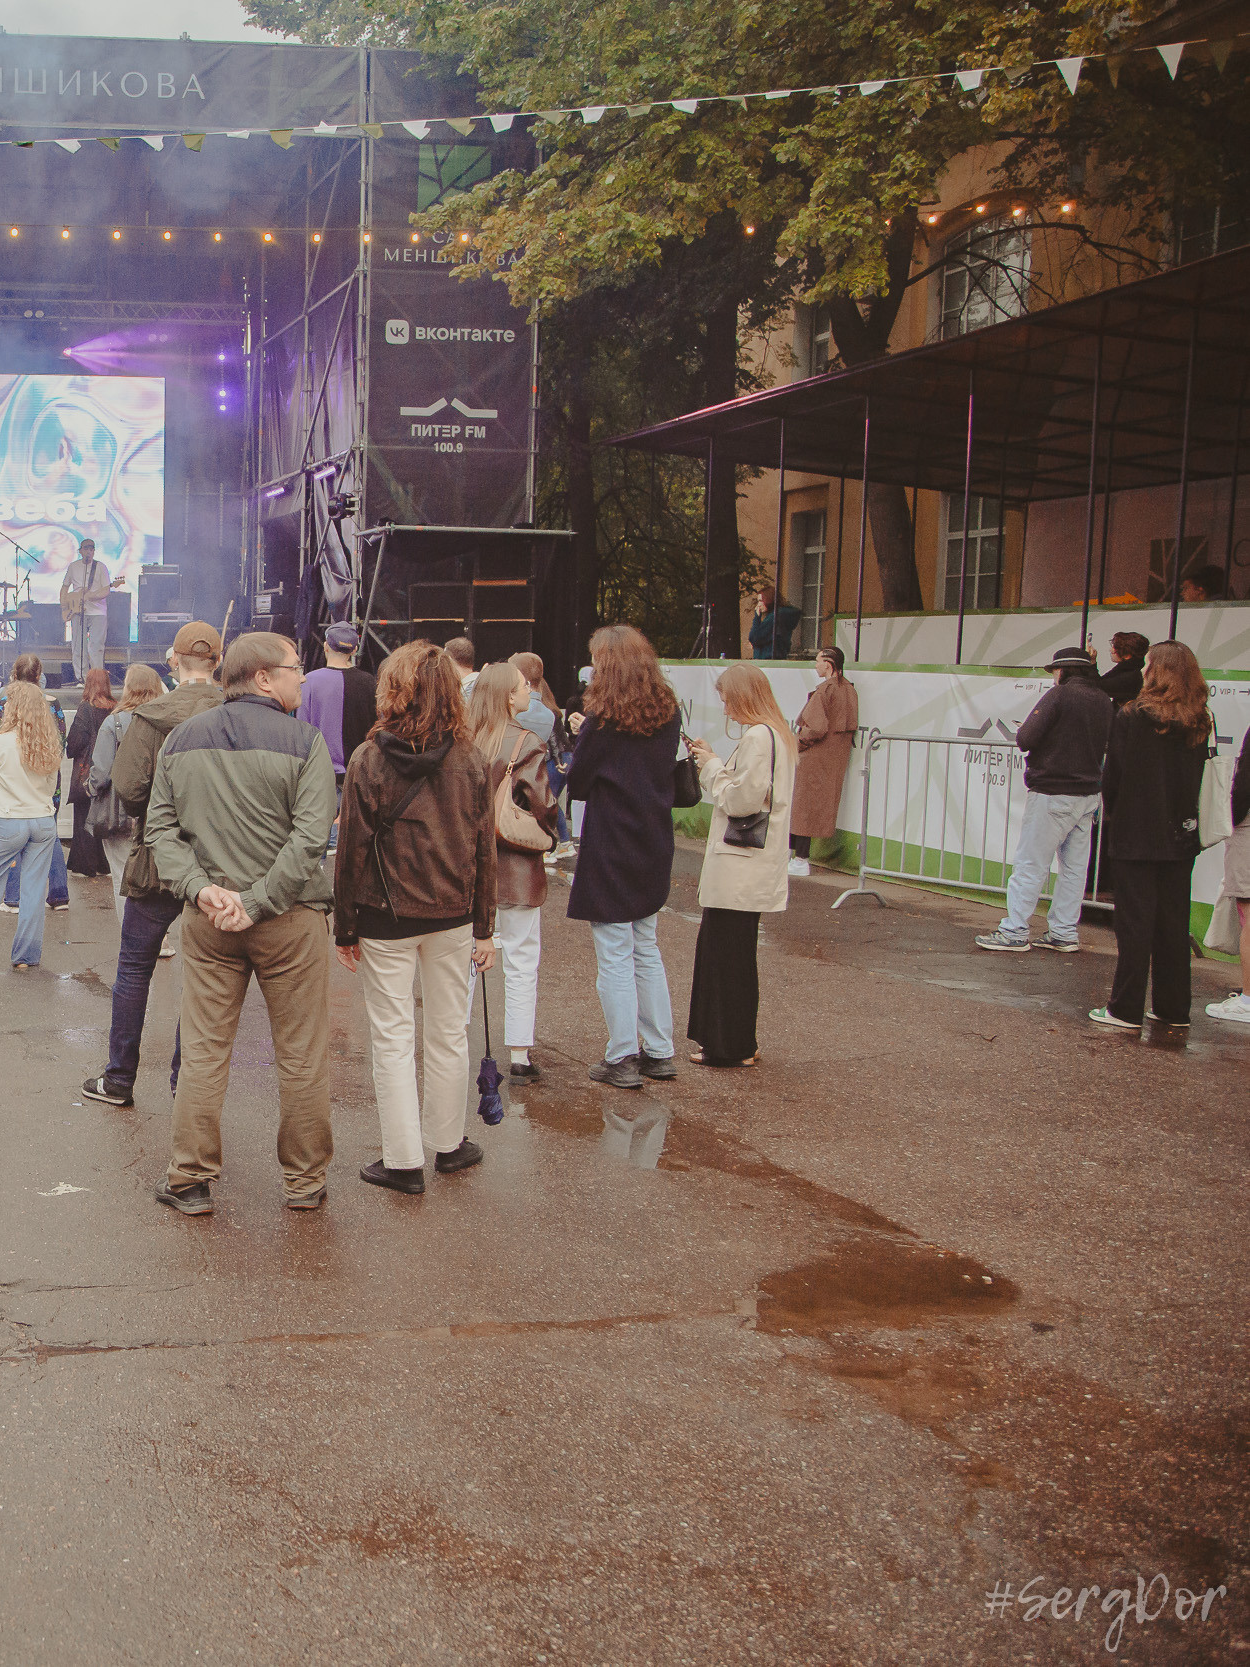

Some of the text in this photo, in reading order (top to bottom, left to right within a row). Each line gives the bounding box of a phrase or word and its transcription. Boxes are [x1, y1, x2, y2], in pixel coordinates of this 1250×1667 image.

[411, 423, 486, 438] ПИТЕР FM
[433, 442, 464, 453] 100.9
